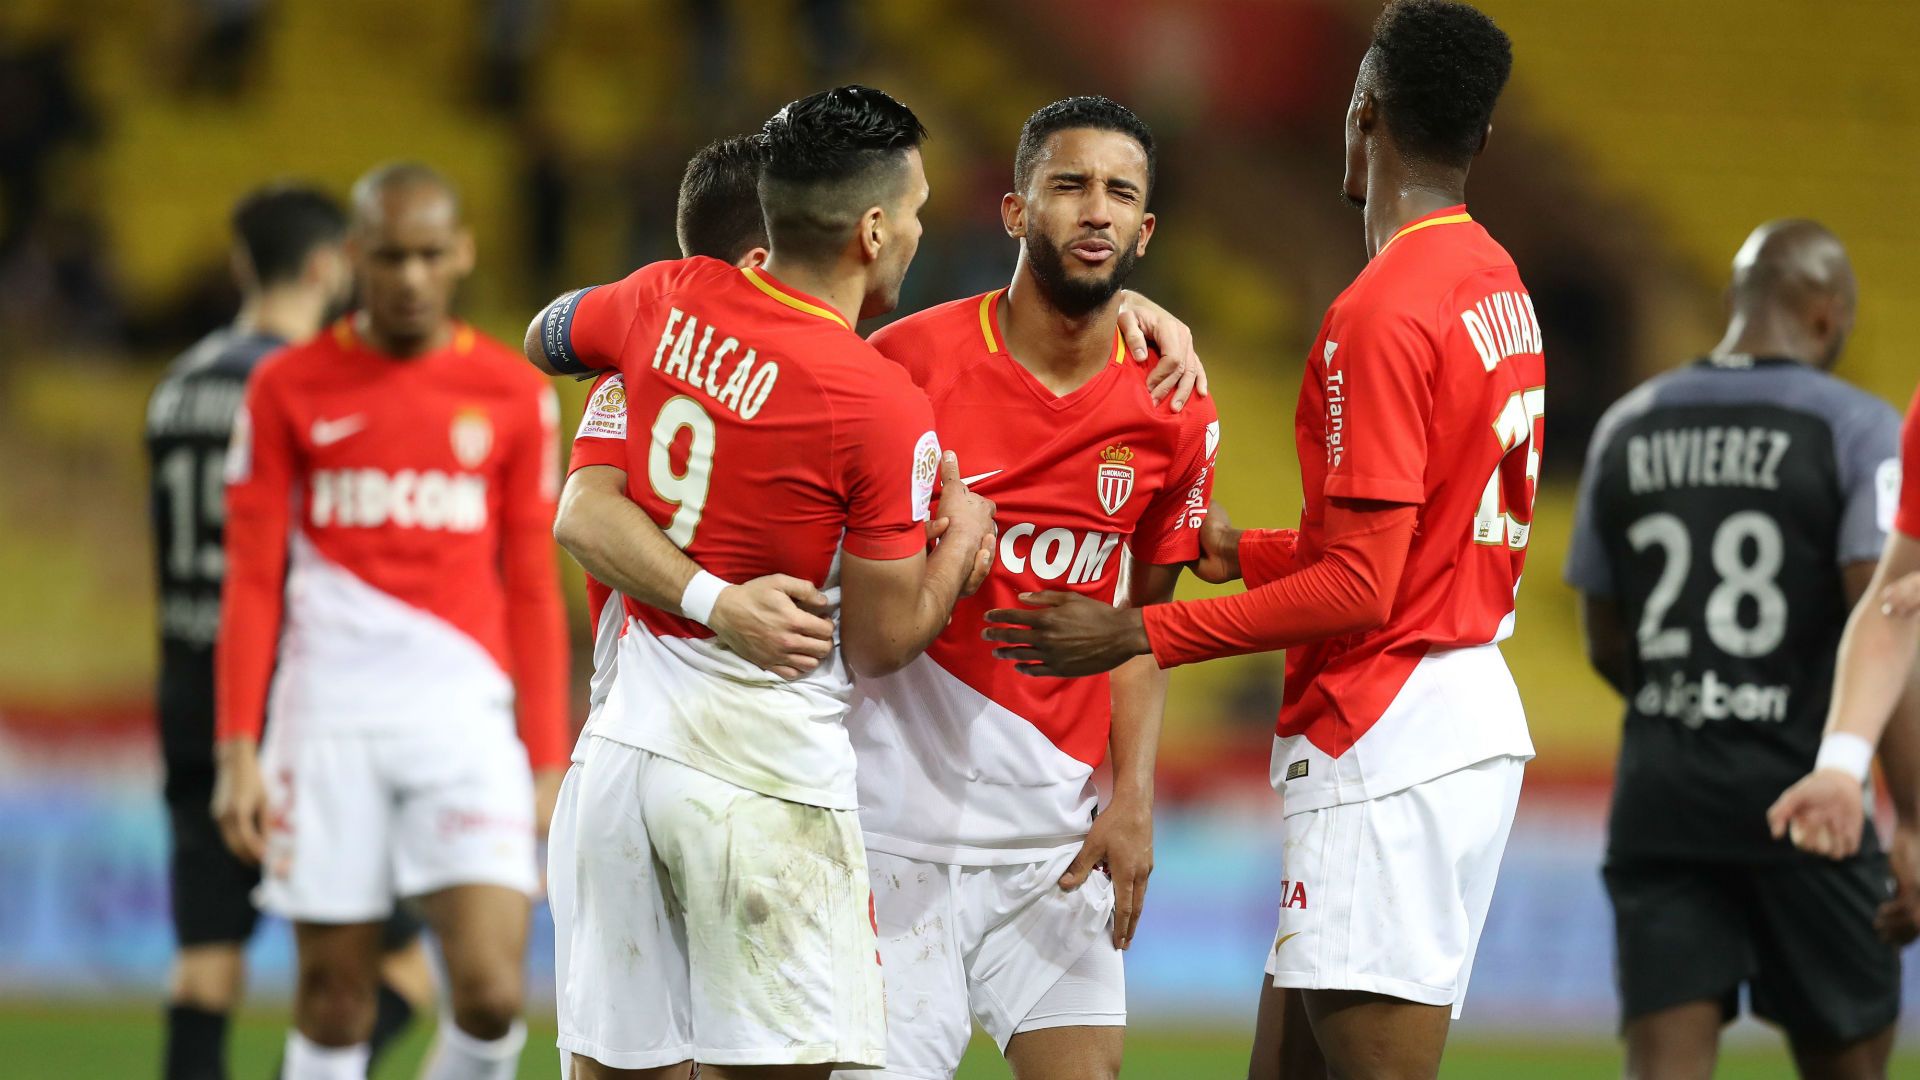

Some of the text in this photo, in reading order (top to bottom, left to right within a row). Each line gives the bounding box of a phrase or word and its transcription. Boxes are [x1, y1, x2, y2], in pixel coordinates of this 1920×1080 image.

[547, 306, 560, 357] RESPECT
[556, 316, 570, 362] RACISM
[652, 306, 779, 421] FALCAO
[584, 426, 622, 435] Conforama
[1327, 369, 1345, 467] Triangle
[1627, 426, 1791, 494] RIVIEREZ
[648, 394, 716, 551] 9
[1473, 384, 1546, 551] 15
[1626, 509, 1789, 661] 28
